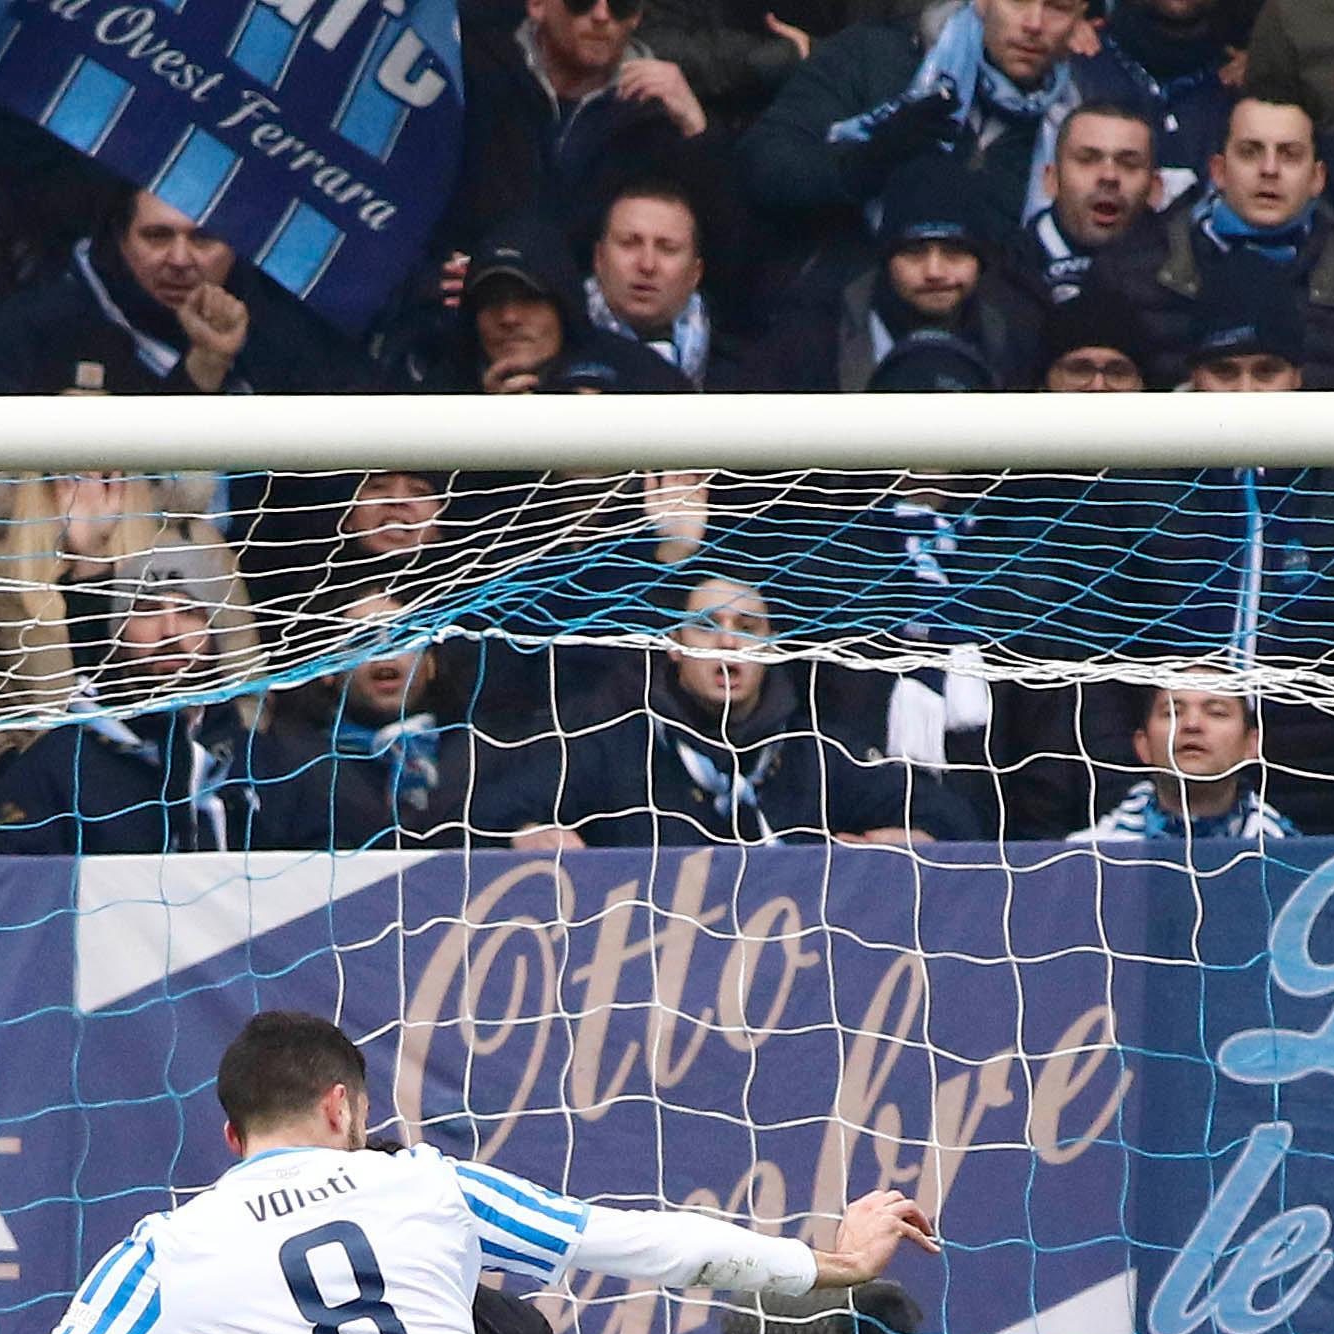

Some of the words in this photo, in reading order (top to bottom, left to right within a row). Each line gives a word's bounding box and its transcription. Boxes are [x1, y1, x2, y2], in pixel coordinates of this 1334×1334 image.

[94, 5, 226, 101] Ovest
[216, 89, 398, 231] Ferrara
[396, 848, 819, 1158] Otto
